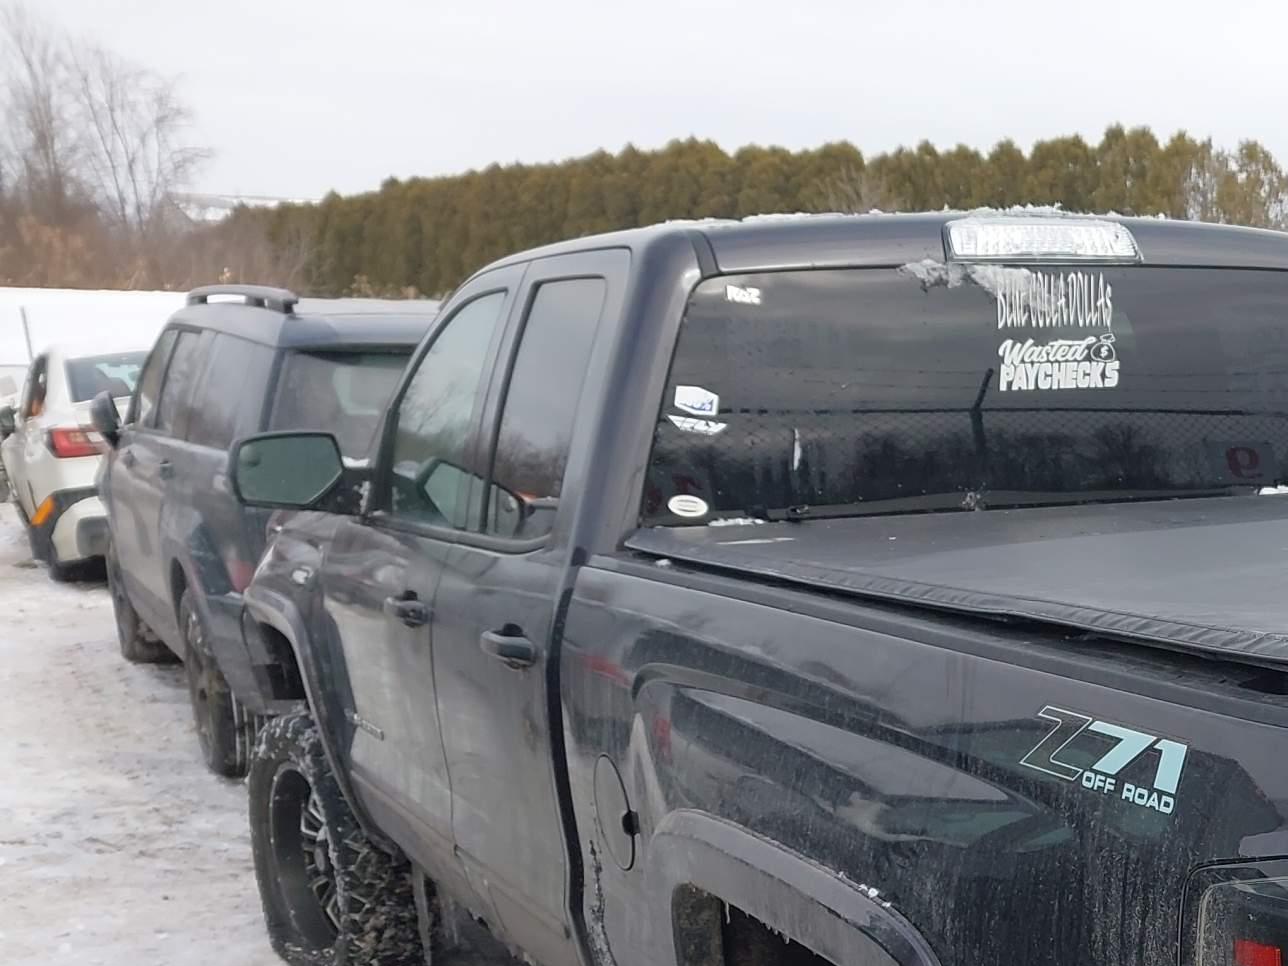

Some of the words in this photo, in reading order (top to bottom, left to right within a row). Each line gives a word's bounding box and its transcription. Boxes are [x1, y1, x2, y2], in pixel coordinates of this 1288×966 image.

[999, 337, 1097, 367] Wasted
[999, 361, 1120, 391] PAYCHECKS
[1019, 704, 1188, 795] Z71
[1082, 771, 1116, 794] OFF
[1121, 783, 1175, 814] ROAD
